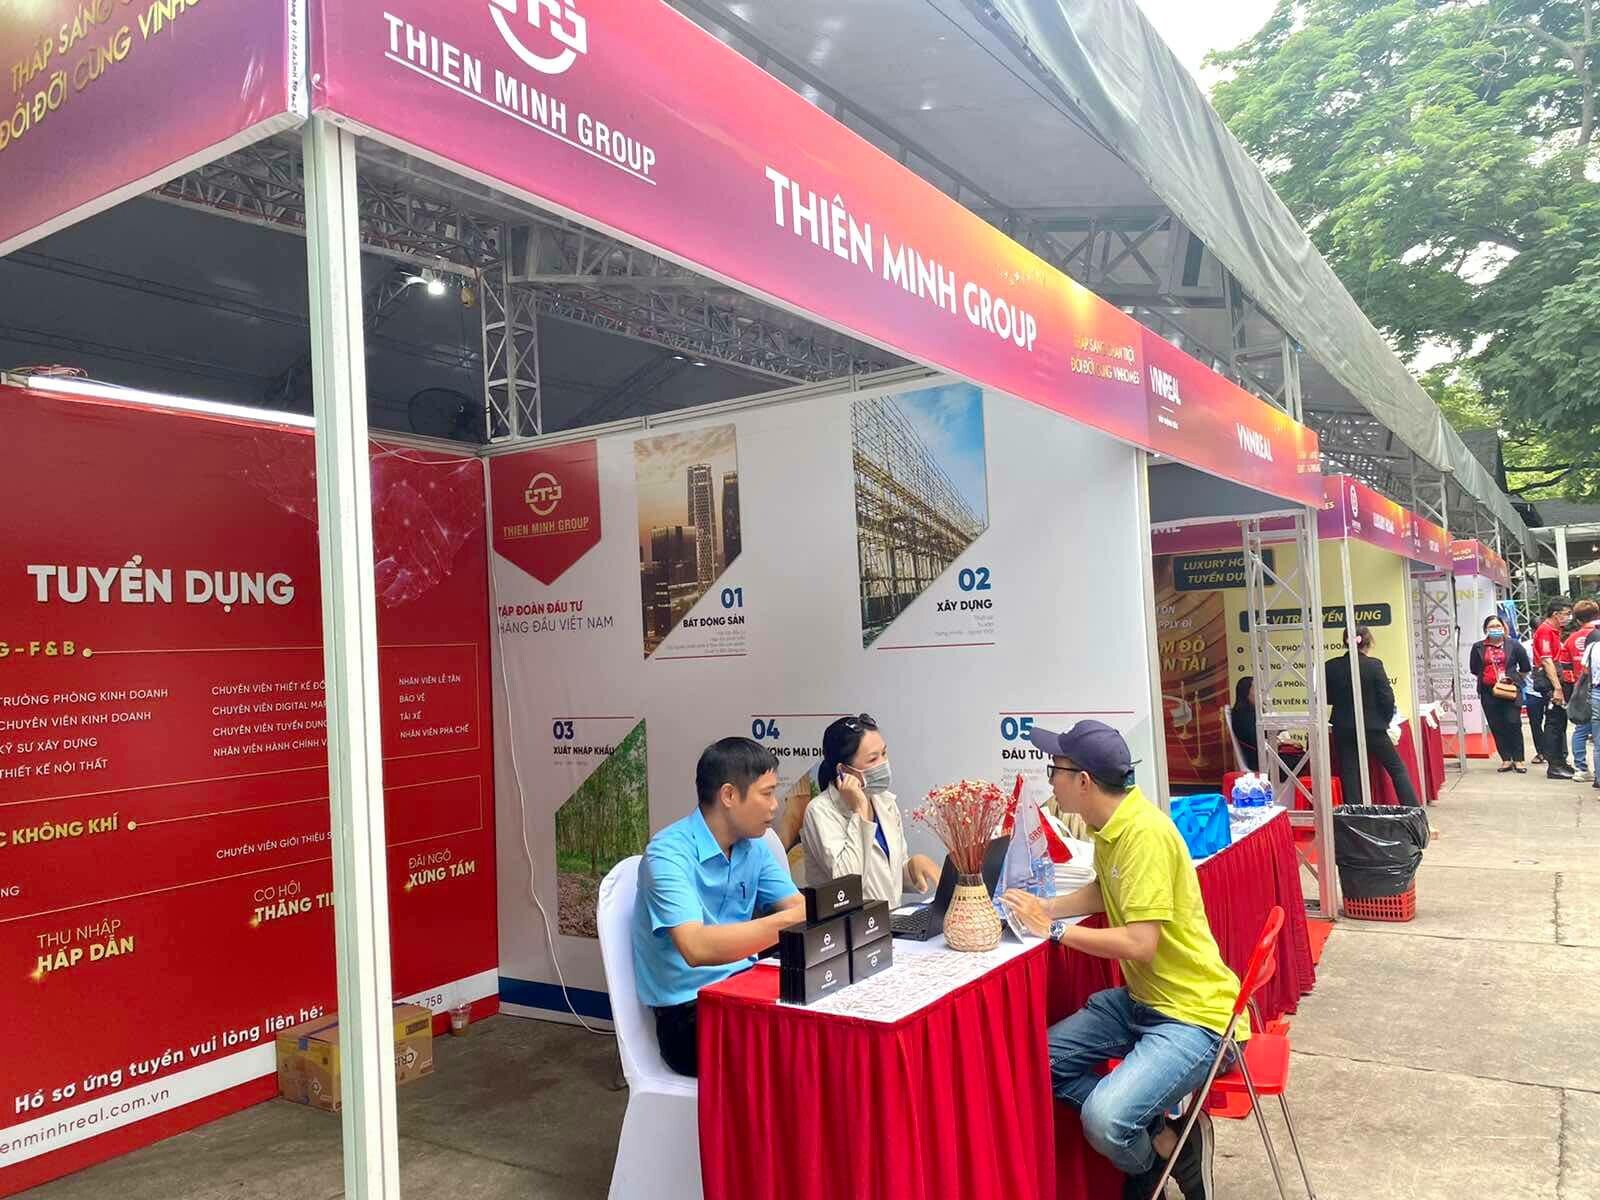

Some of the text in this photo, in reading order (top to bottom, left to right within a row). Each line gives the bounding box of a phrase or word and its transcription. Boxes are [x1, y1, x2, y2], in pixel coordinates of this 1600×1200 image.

[383, 12, 482, 94] THIEN
[495, 69, 567, 133] MINH
[577, 113, 656, 175] GROUP
[765, 165, 1037, 351] THIÊN MINH GROUP
[532, 521, 555, 534] MINH
[558, 516, 590, 531] GROUP
[1184, 559, 1226, 571] LUXURY
[27, 554, 294, 612] TUYỂN DỤNG
[958, 567, 992, 591] 02
[570, 599, 583, 612] TƯ
[721, 587, 743, 609] 01
[587, 615, 614, 629] NAM
[53, 690, 97, 704] PHÒNG
[99, 690, 126, 701] KINH
[129, 688, 168, 699] DOANH
[211, 684, 250, 696] CHUYÊN
[252, 682, 273, 693] VIÊN
[211, 704, 251, 716] CHUYÊN
[253, 703, 273, 713] VIÊN
[275, 702, 309, 711] DIGITAL
[0, 711, 152, 731] CHUYÊN VIÊN KINH DOANH
[212, 725, 251, 737] CHUYÊN
[254, 723, 274, 733] VIÊN
[553, 720, 574, 740] 03
[751, 718, 780, 740] 04
[1000, 717, 1035, 741] 05
[16, 740, 35, 754] SƯ
[37, 739, 60, 752] XÂY
[63, 737, 98, 751] DỰNG
[213, 745, 240, 757] NHÂN
[242, 742, 264, 754] VIÊN
[292, 738, 319, 749] CHÍNH
[36, 760, 51, 775] KẾ
[54, 760, 76, 775] NỘI
[79, 756, 108, 770] THẤT
[12, 819, 84, 845] KHÔNG
[88, 812, 118, 835] KHÍ
[216, 845, 255, 859] CHUYÊN
[257, 839, 278, 853] VIÊN
[254, 879, 301, 902] CƠ HỘI
[254, 897, 312, 923] THĂNG
[37, 918, 122, 950] THU NHẬP
[37, 932, 135, 973] HẤP DẪN
[425, 994, 443, 1008] 758
[15, 1005, 325, 1114] Hồ sơ ứng tuyển vui lòng liên hệ:
[0, 1087, 170, 1154] enminhreal.com.vn
